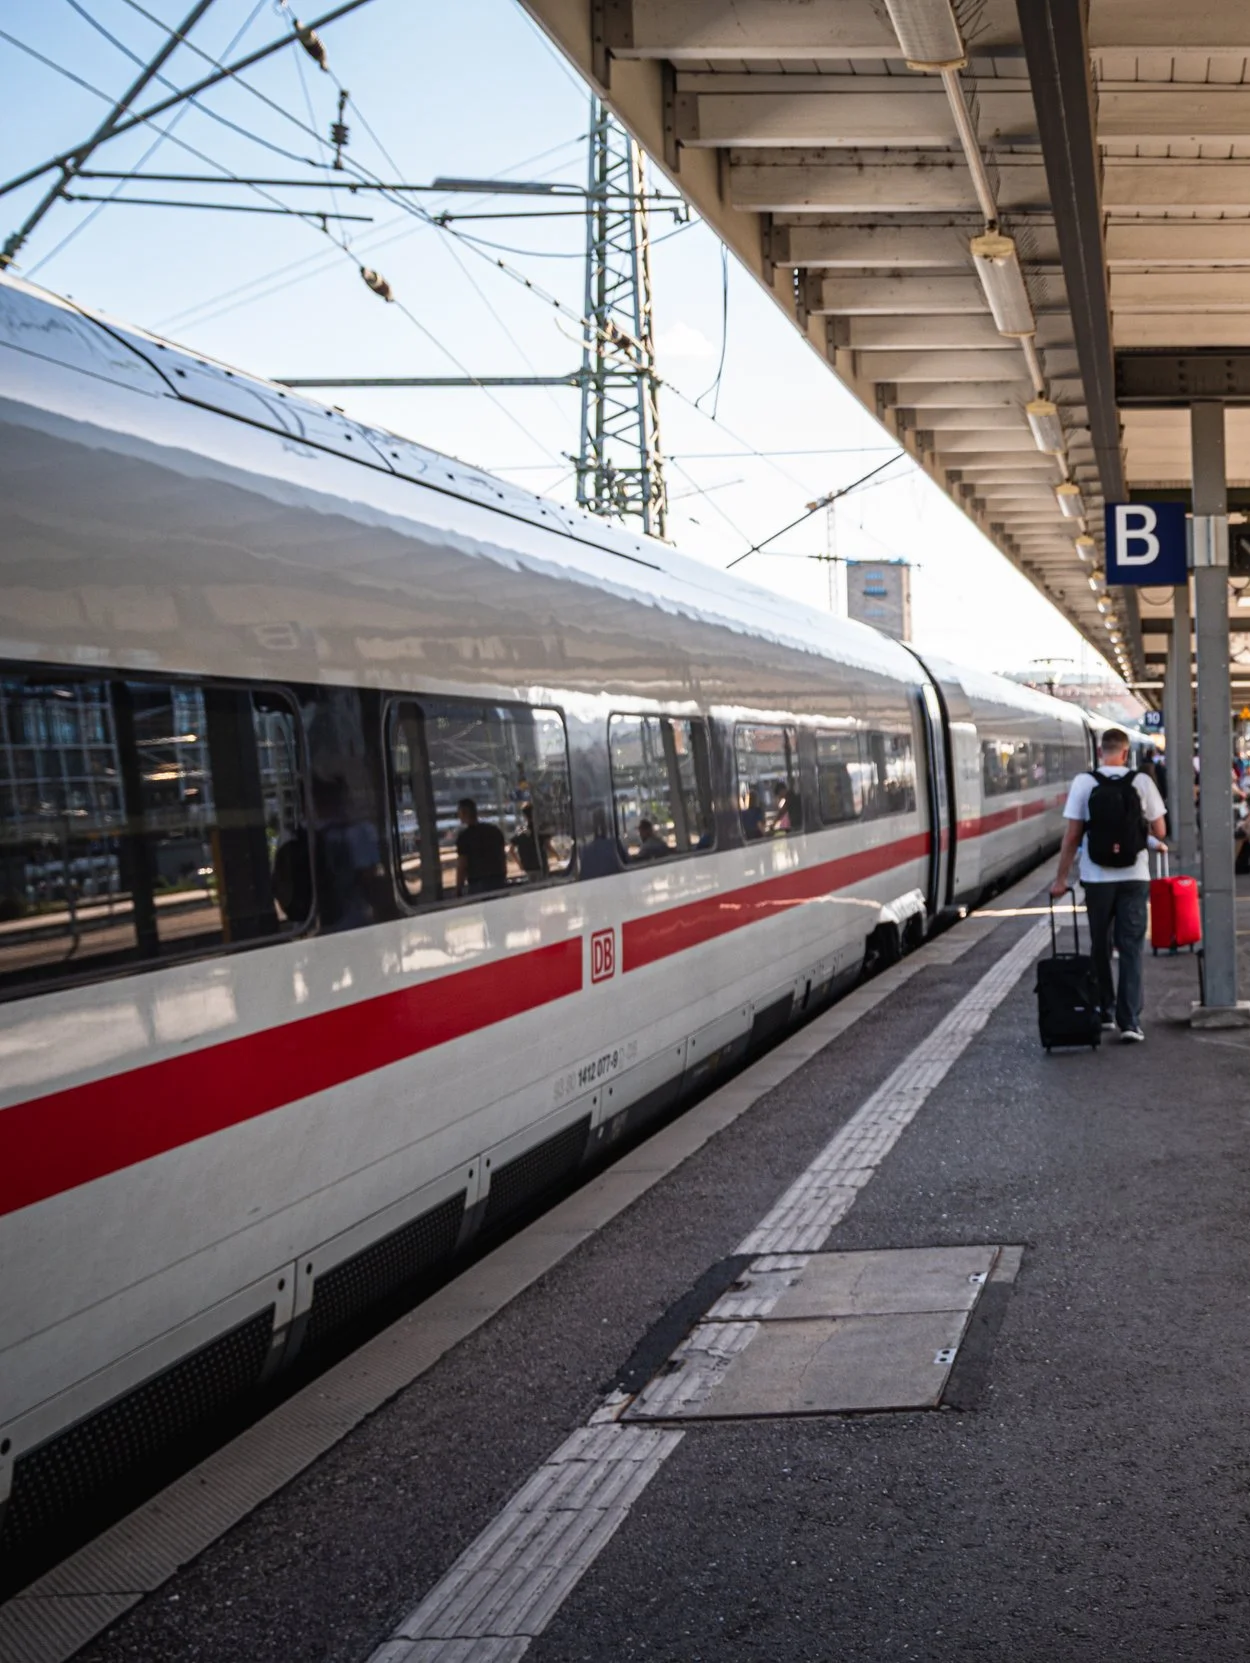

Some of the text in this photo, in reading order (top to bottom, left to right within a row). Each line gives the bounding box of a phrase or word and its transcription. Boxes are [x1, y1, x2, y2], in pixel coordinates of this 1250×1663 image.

[1115, 505, 1160, 566] B
[1146, 711, 1160, 724] 10
[594, 936, 613, 976] DB
[578, 1061, 596, 1087] 1412
